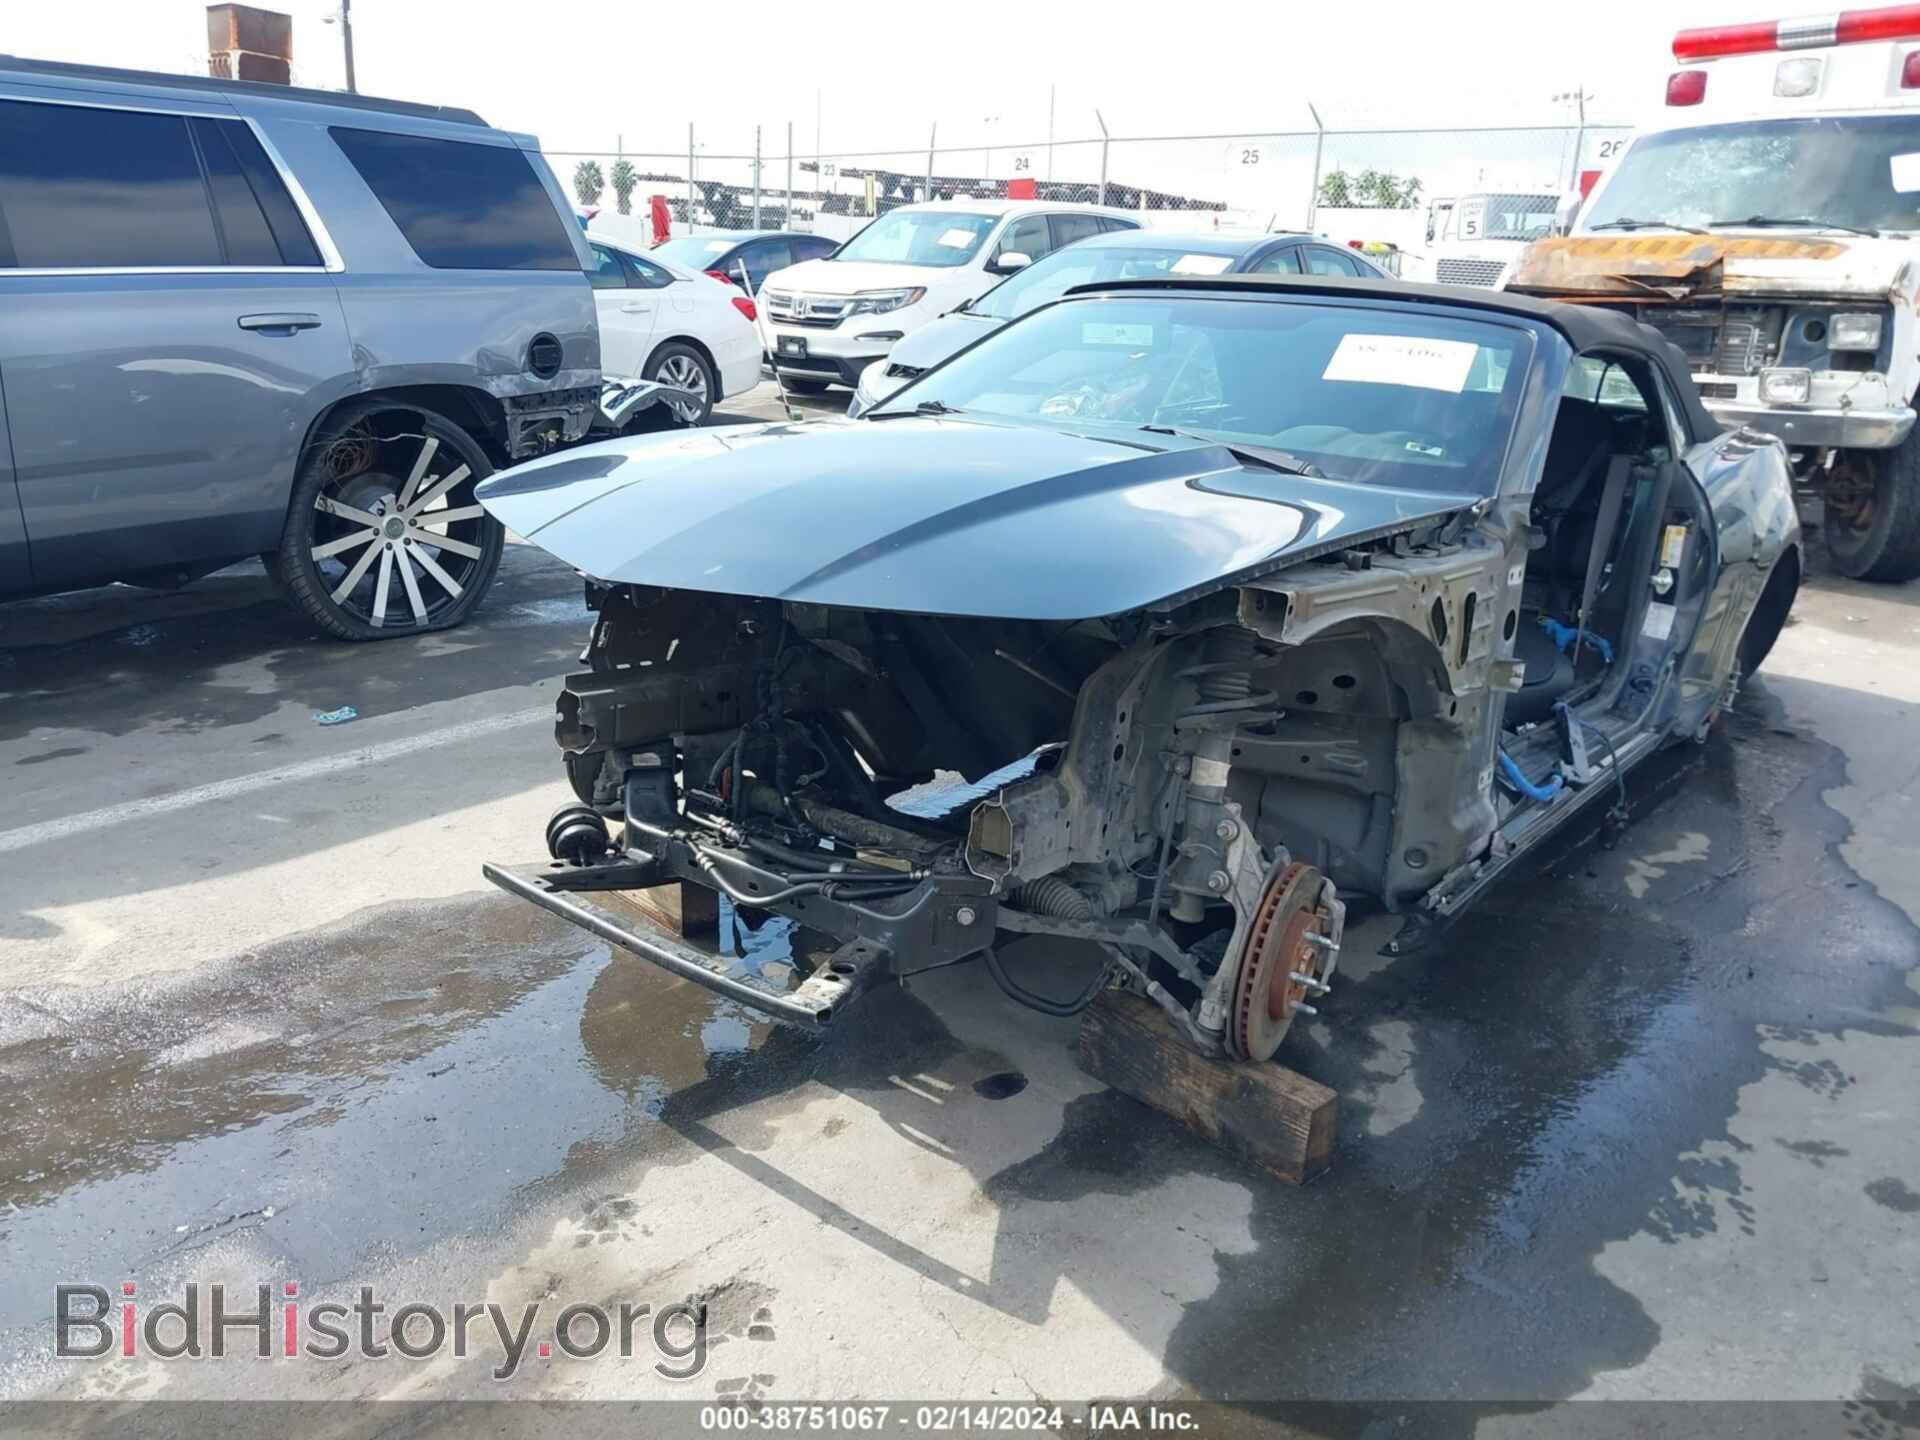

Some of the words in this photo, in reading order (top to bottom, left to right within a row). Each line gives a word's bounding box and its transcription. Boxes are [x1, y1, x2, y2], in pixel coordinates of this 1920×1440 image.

[1015, 157, 1029, 171] 24
[1242, 150, 1259, 164] 25
[824, 164, 835, 176] 23
[1466, 220, 1477, 235] 5
